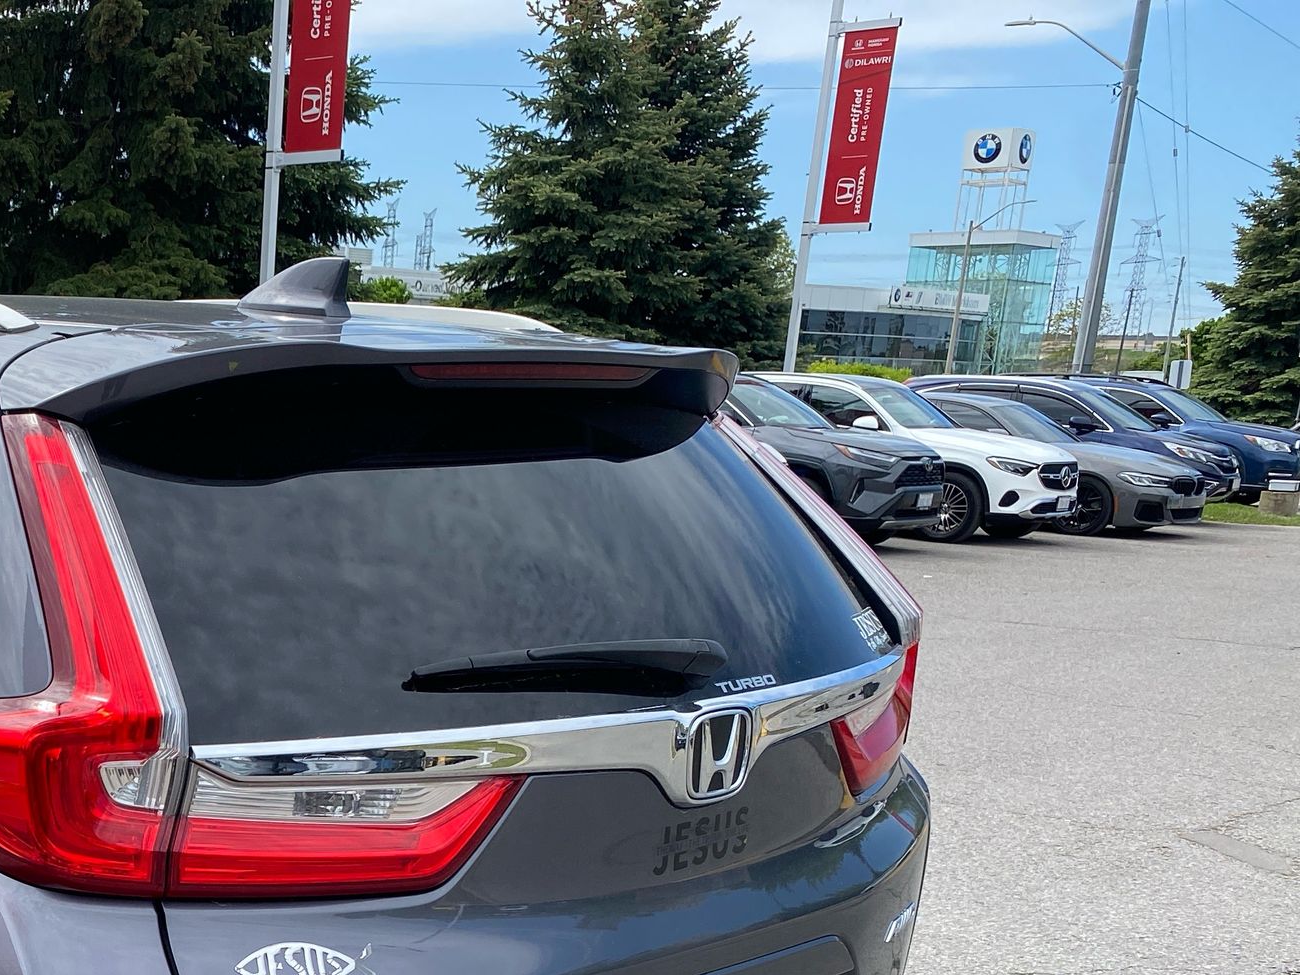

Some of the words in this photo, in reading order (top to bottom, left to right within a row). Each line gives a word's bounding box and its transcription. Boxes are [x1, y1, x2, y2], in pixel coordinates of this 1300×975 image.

[854, 56, 892, 67] DILAWRI
[322, 70, 333, 135] HONDA
[848, 88, 864, 142] Certified
[860, 87, 874, 142] PRE-OWNED
[854, 166, 867, 214] HONDA
[714, 674, 777, 694] TURBO
